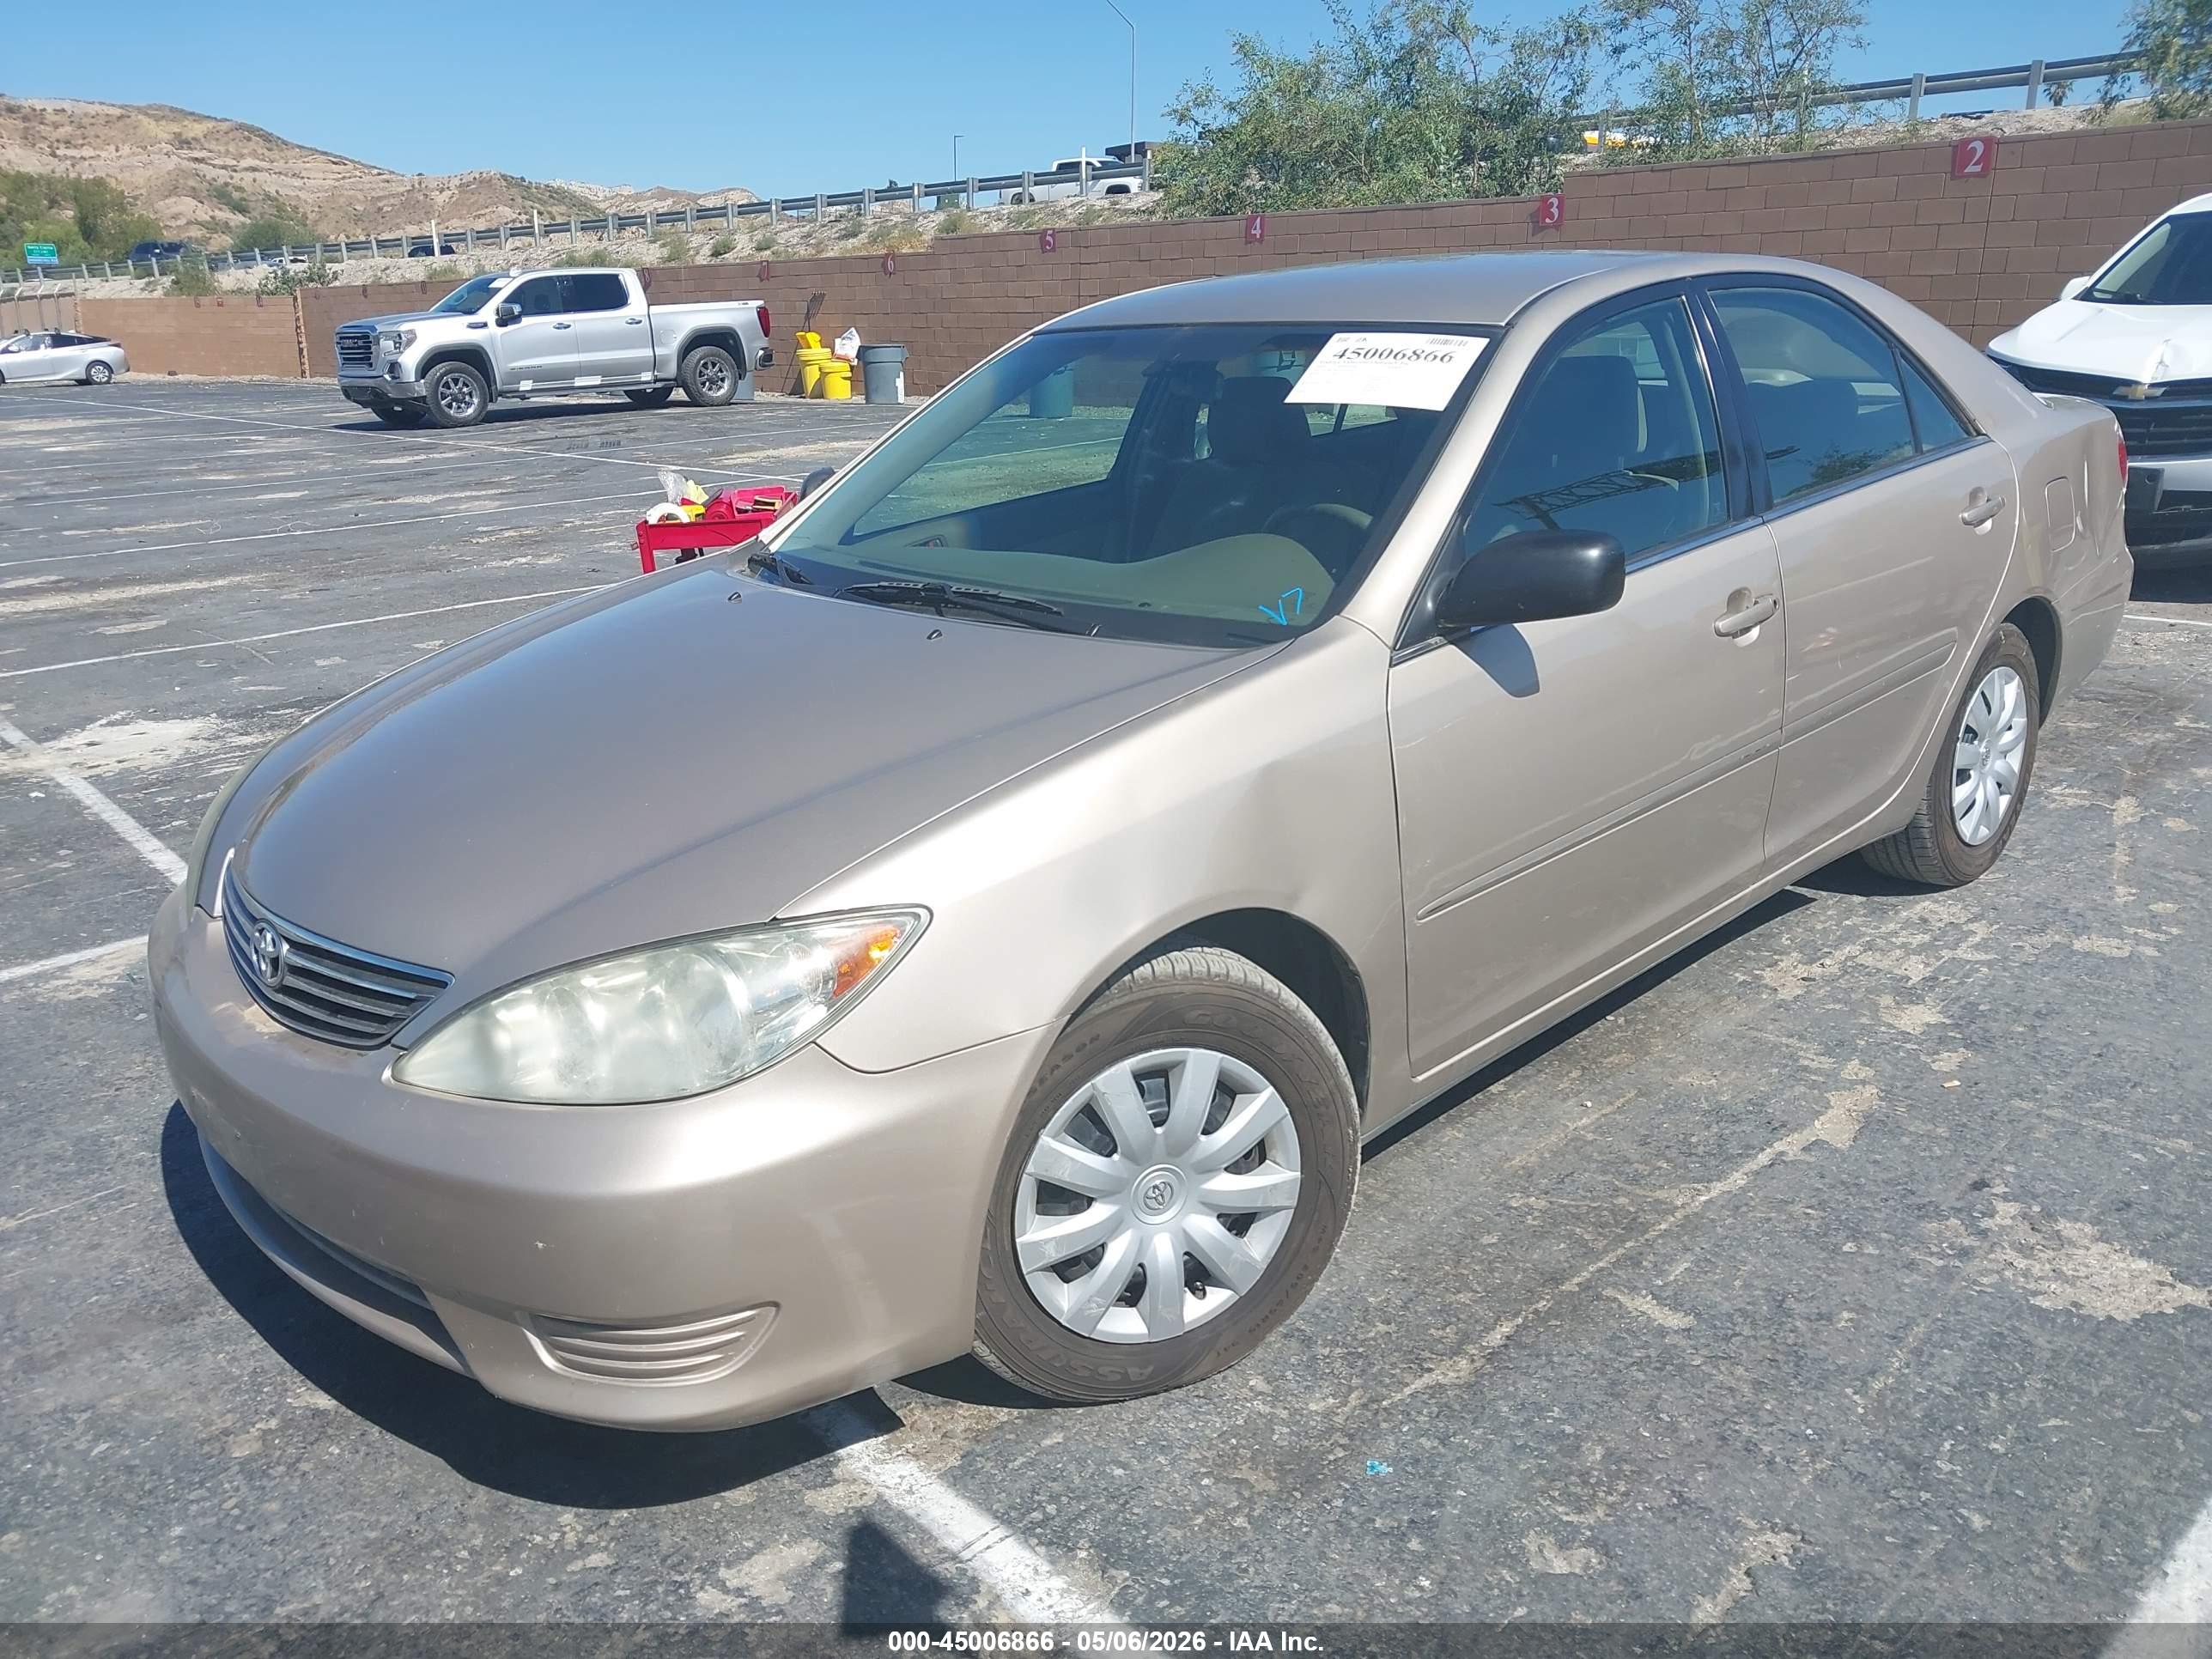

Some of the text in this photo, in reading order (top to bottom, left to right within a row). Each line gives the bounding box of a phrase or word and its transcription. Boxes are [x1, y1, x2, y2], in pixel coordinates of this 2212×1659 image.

[1964, 140, 1984, 173] 2
[1545, 197, 1559, 223] 3
[1250, 216, 1262, 239] 4
[1045, 229, 1054, 250] 5
[887, 253, 895, 273] 6
[1333, 347, 1455, 364] 45006866
